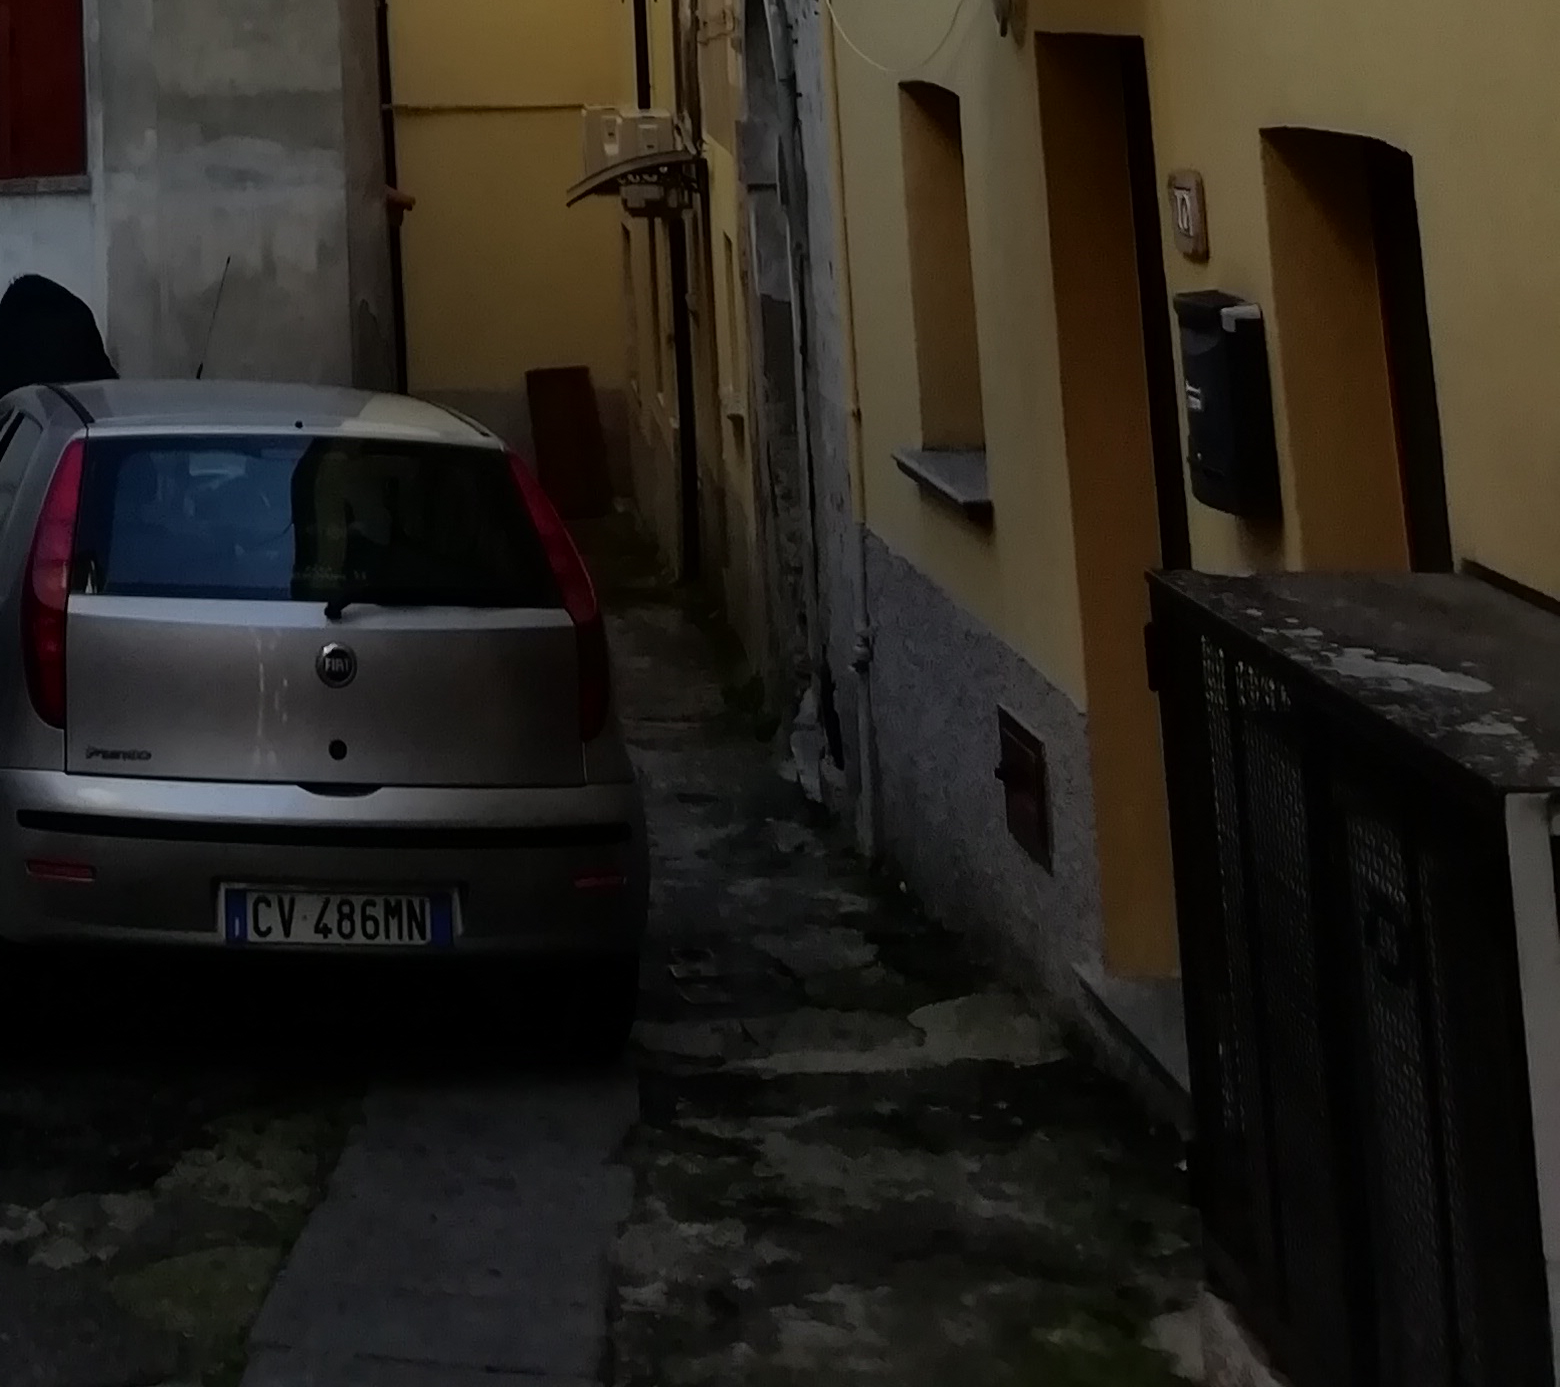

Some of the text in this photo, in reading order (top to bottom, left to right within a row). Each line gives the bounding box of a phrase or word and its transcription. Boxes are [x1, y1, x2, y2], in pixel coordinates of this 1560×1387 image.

[325, 657, 350, 672] FIAT
[252, 896, 294, 938] CV
[314, 897, 427, 940] 486MN
